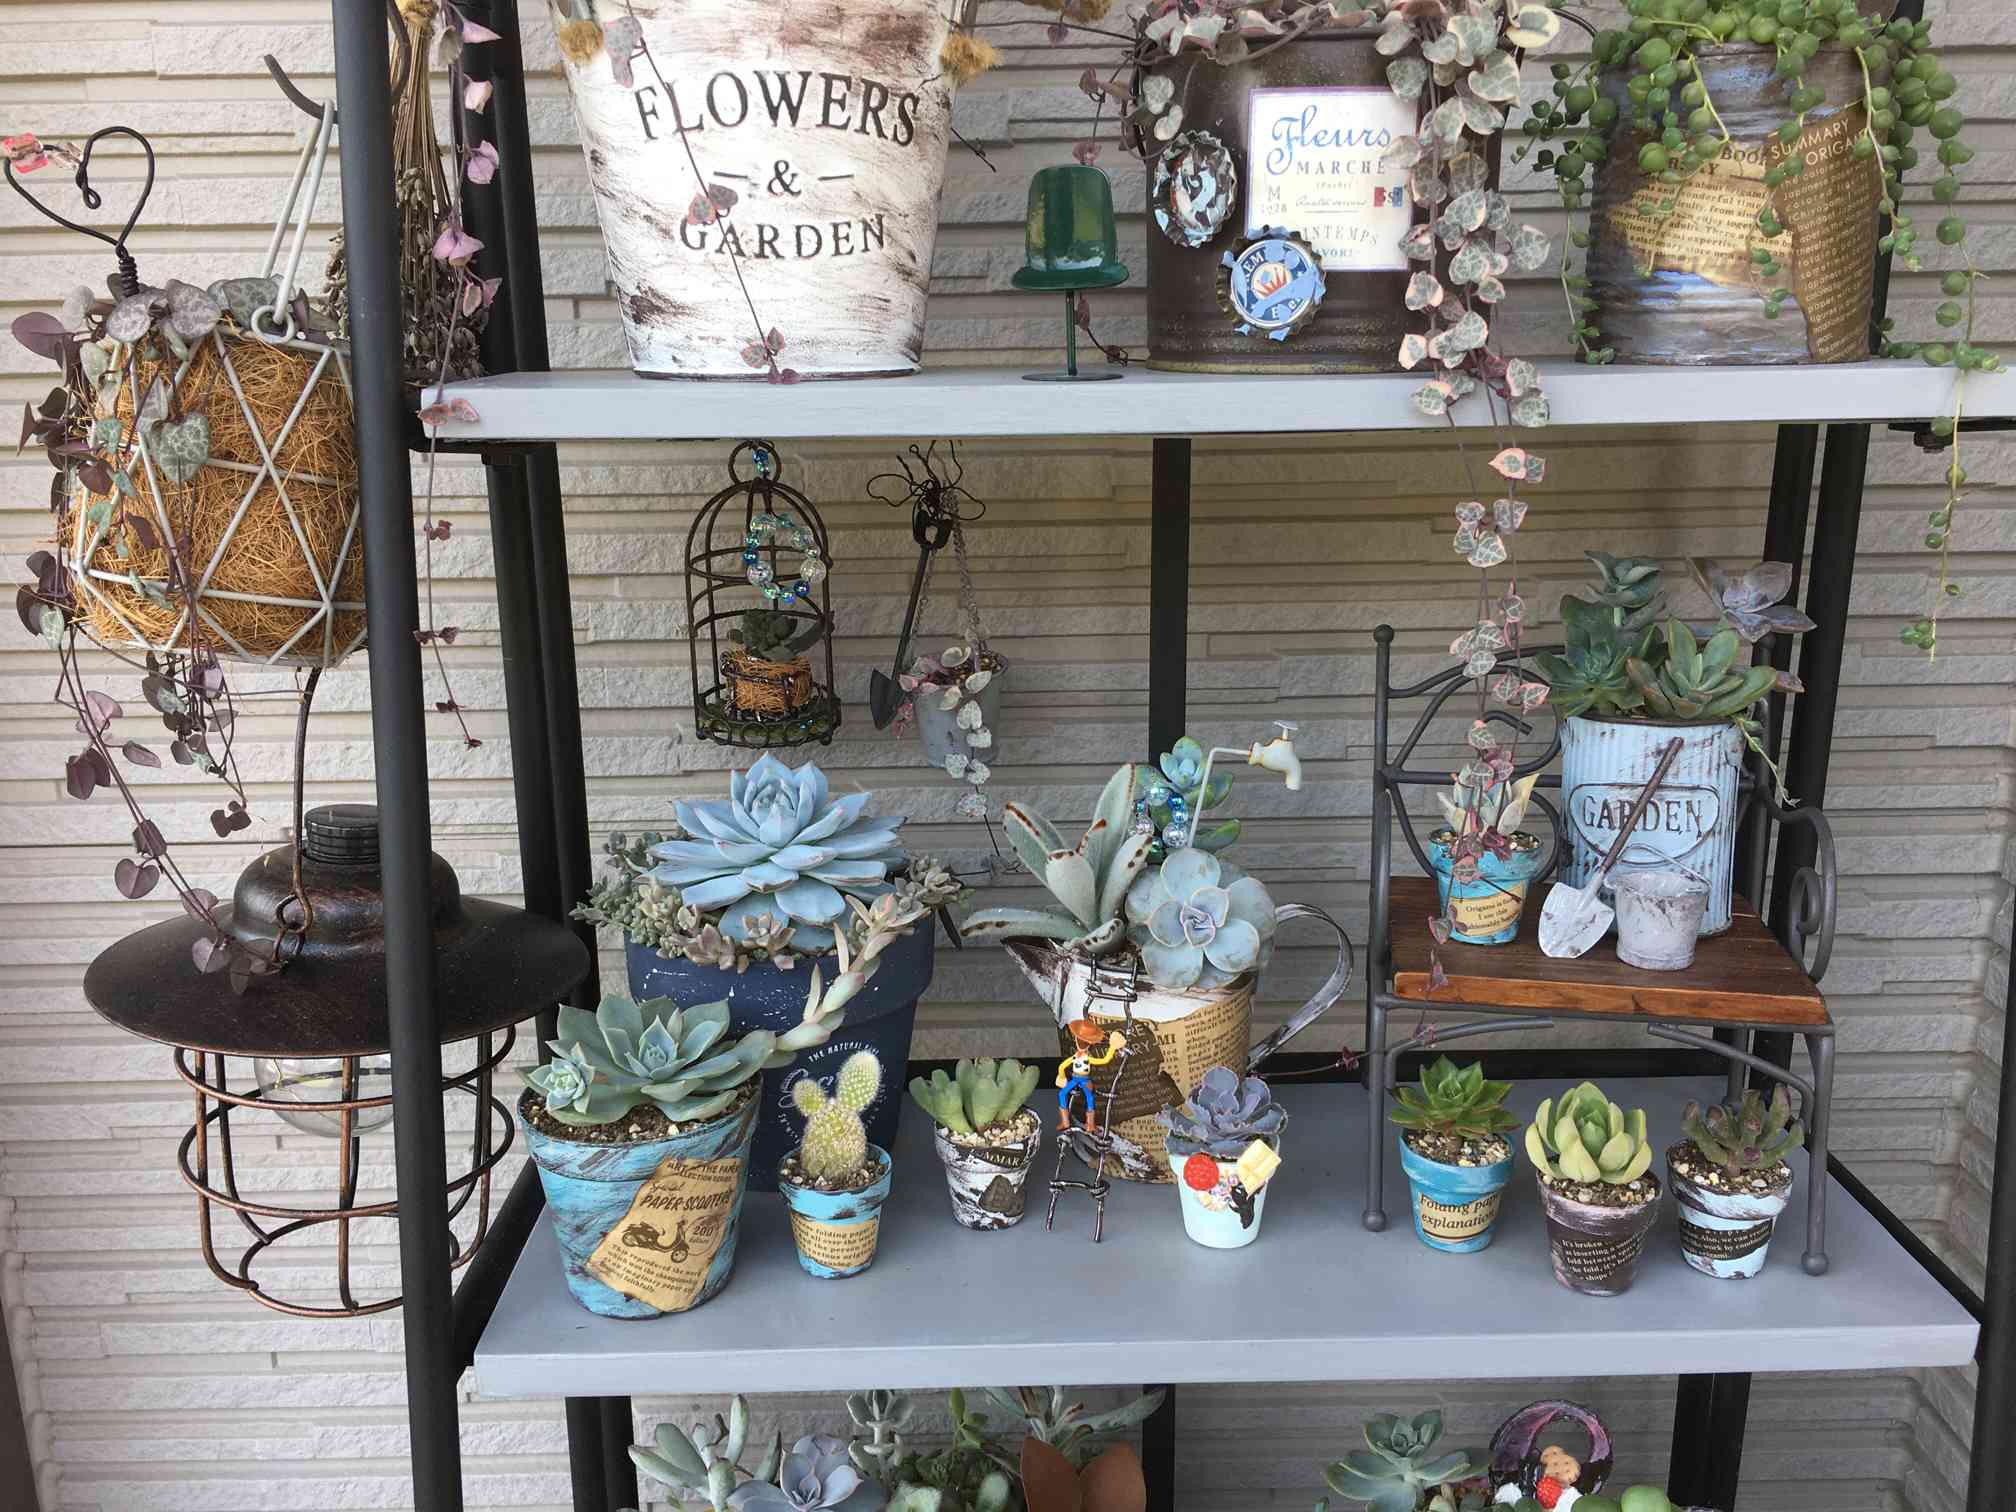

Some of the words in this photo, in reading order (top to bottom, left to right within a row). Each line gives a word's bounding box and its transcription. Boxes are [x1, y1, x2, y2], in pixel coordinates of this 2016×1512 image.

[634, 70, 920, 147] FLOWERS
[1266, 104, 1391, 176] Fleurs
[767, 159, 801, 197] &
[679, 213, 885, 260] GARDEN
[1583, 794, 1702, 836] GARDEN
[640, 1192, 682, 1212] PAPER
